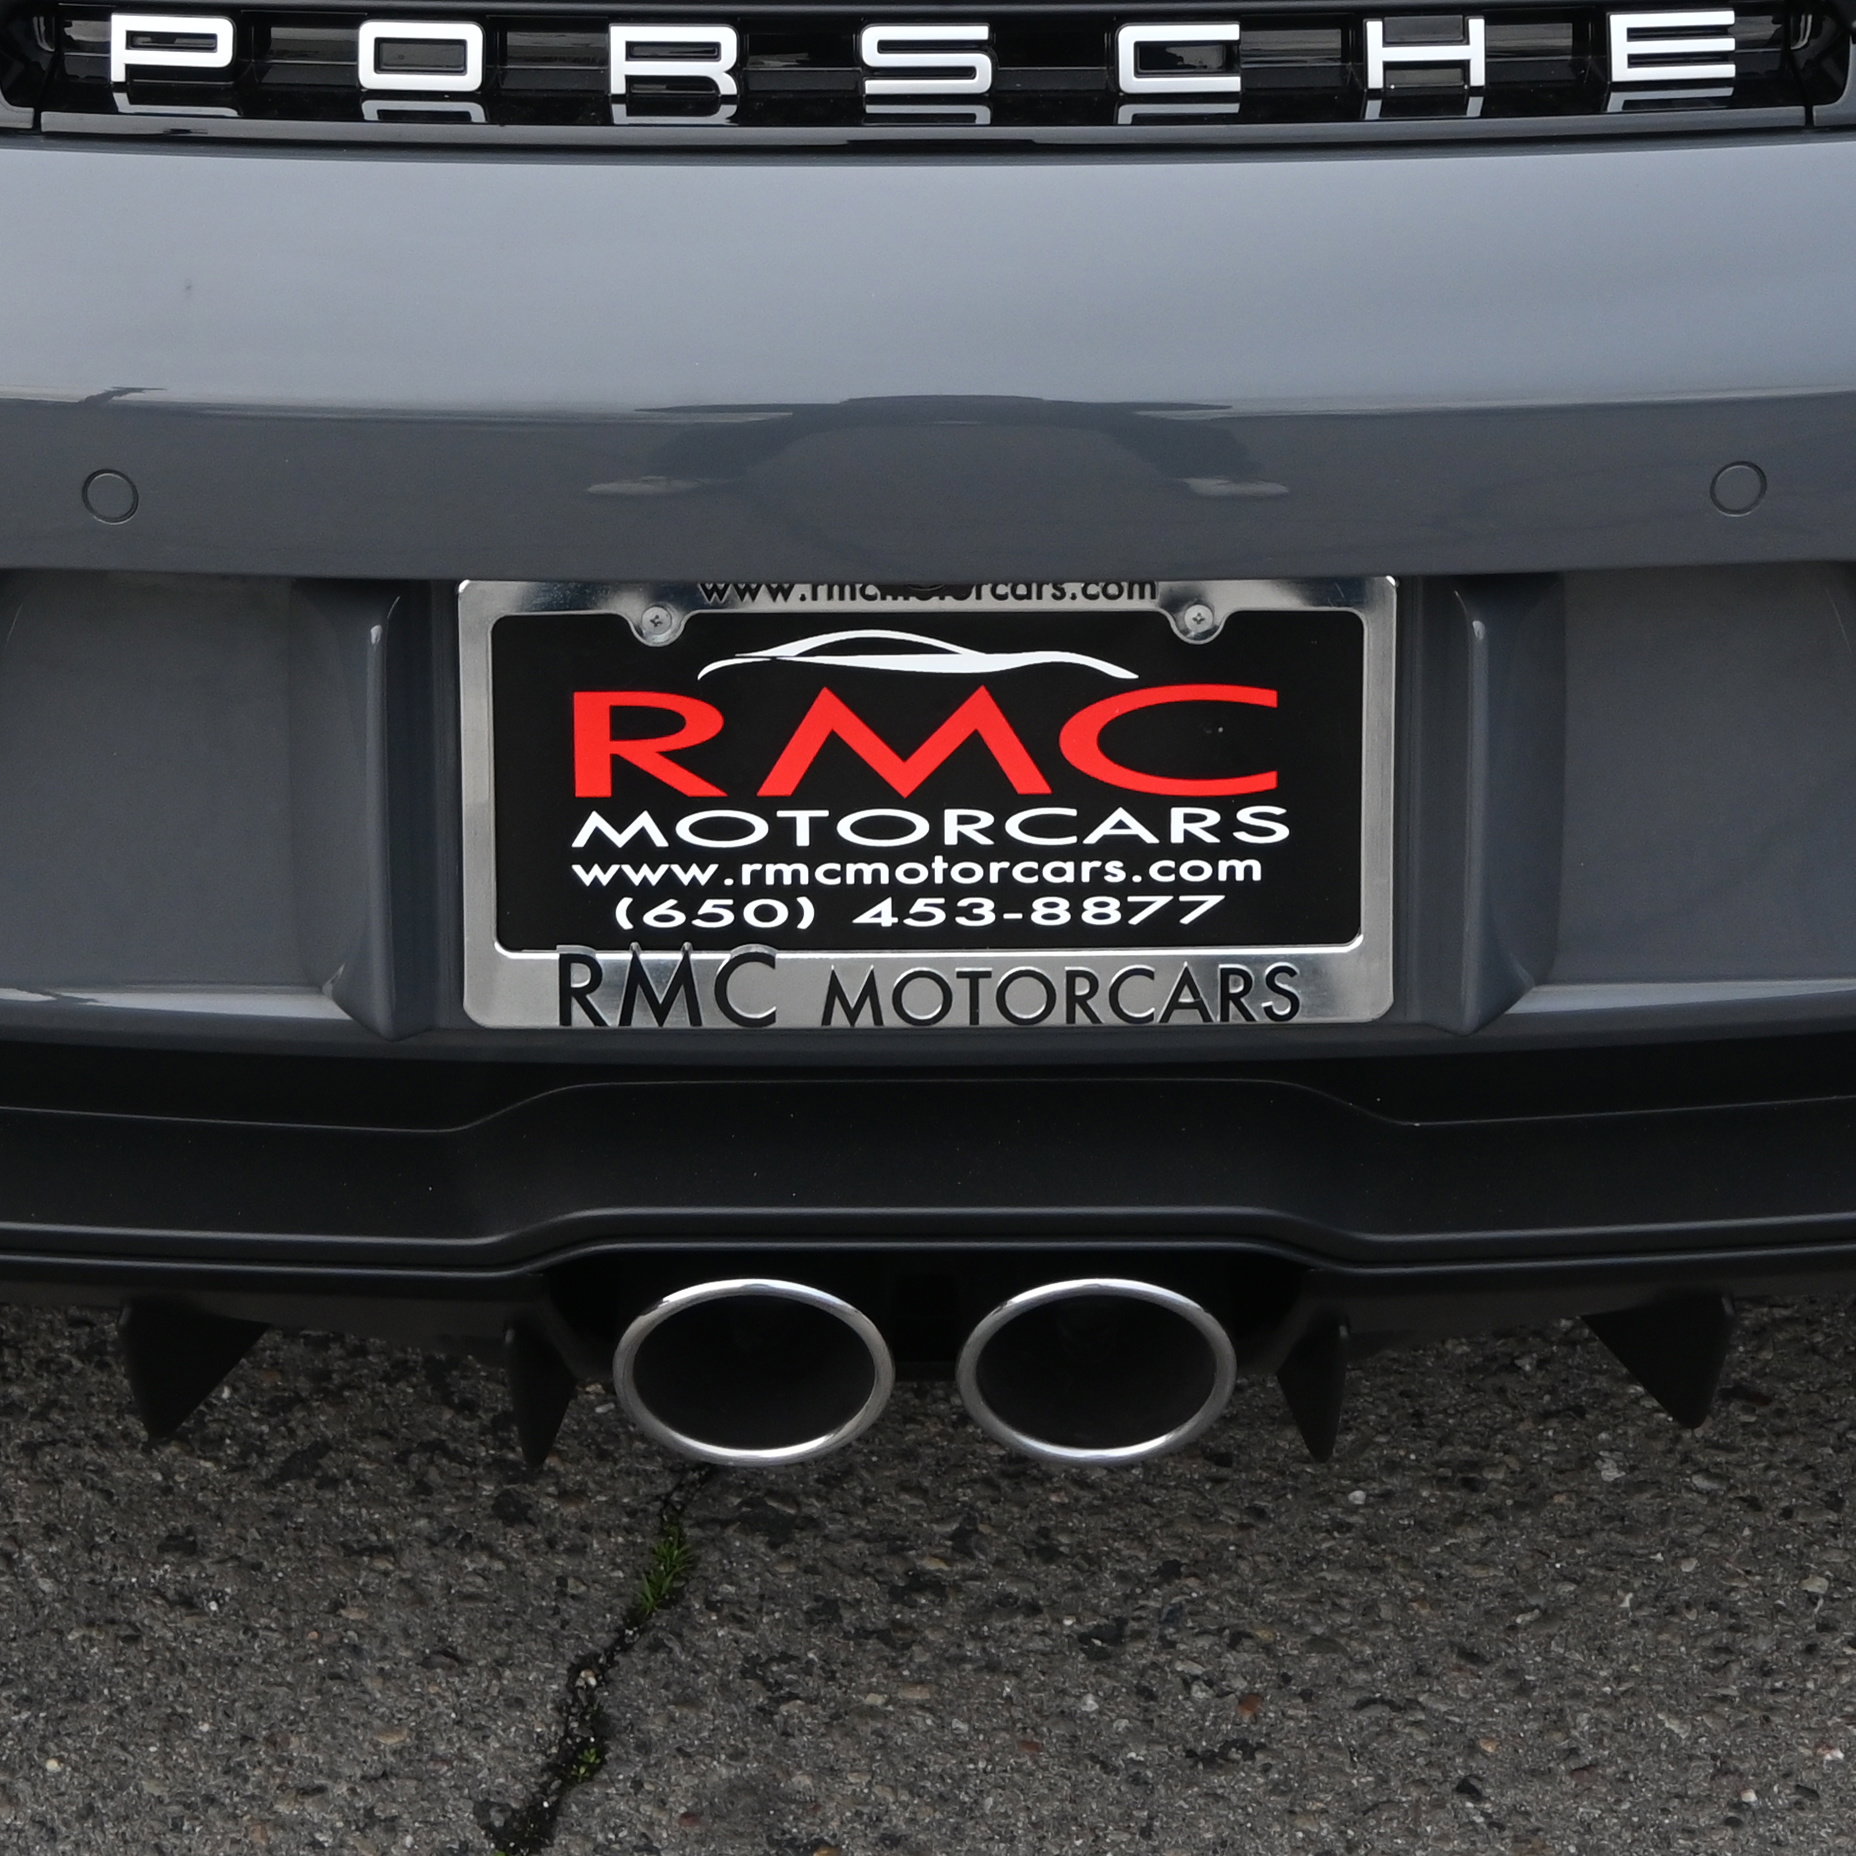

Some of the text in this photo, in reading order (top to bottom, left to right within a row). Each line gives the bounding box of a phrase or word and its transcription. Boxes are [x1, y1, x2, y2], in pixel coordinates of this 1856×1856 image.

[110, 10, 1736, 95] PORSCHE
[573, 683, 1278, 798] RMC
[571, 806, 1290, 849] MOTORCARS
[571, 855, 1263, 887] www.rmcmotorcars.com
[615, 894, 1226, 930] (650) 453-8877
[556, 944, 1301, 1028] RMC MOTORCARS
